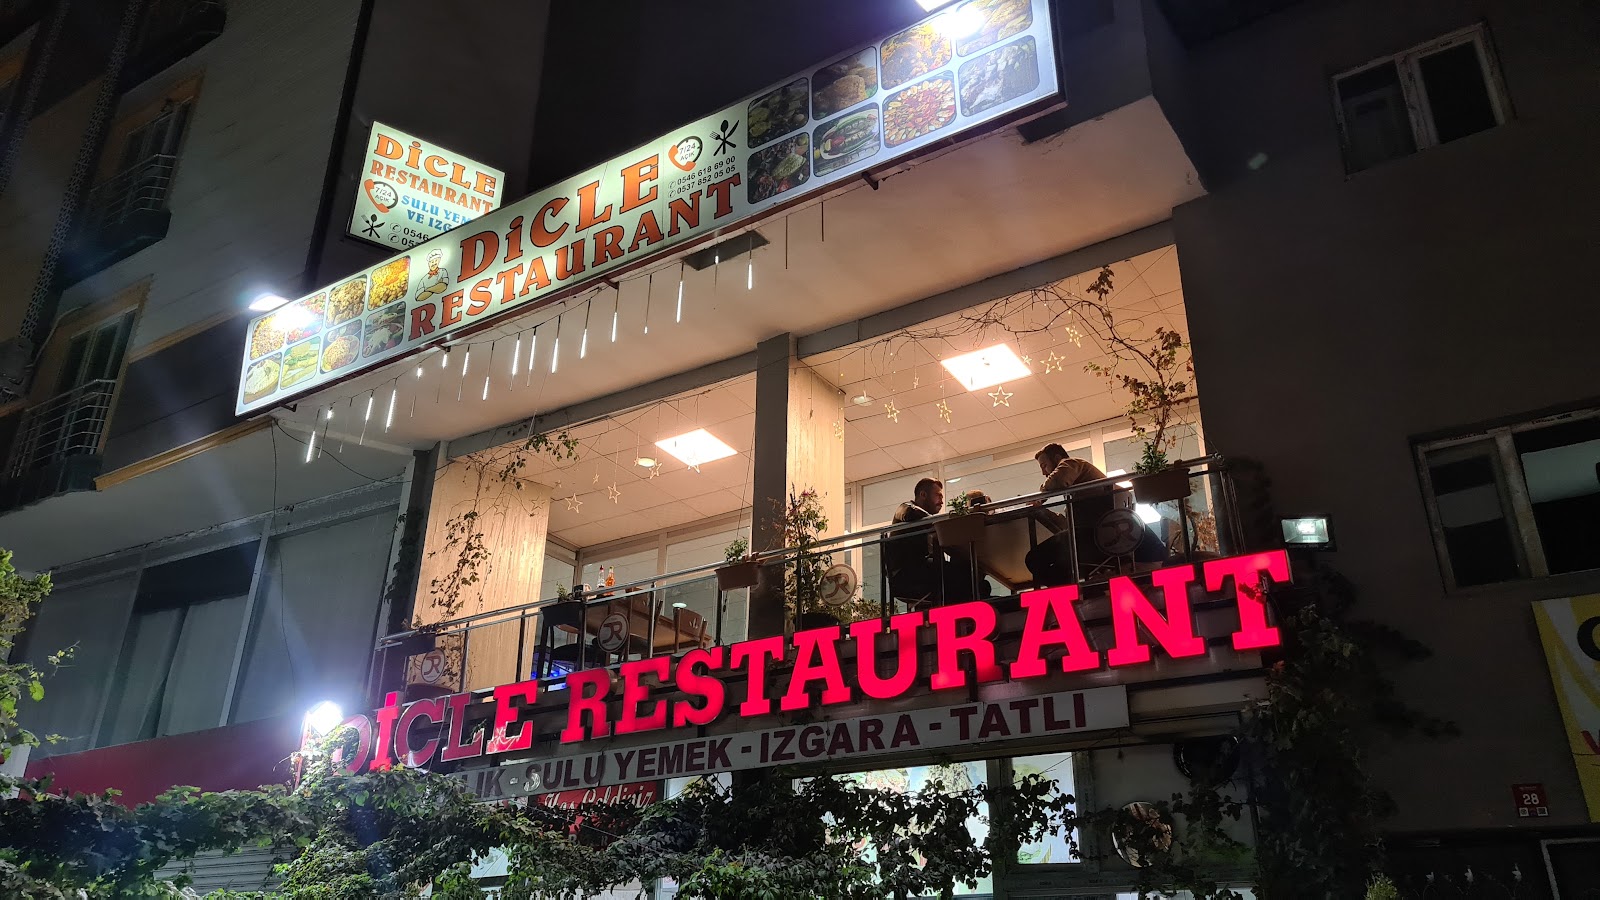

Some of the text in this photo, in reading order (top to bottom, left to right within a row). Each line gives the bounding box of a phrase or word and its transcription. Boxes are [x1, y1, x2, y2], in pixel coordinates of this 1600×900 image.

[679, 143, 696, 155] 7/24
[680, 150, 695, 161] AÇIK
[677, 155, 736, 186] 0546 618 69 00
[677, 164, 736, 195] 0537 852 05 05
[370, 159, 494, 215] RESTAURANT
[375, 187, 392, 198] 7/24
[401, 195, 439, 216] SULU
[407, 209, 425, 225] VE
[403, 227, 429, 241] 0546
[408, 173, 741, 341] RESTAURANT
[560, 549, 1292, 745] RESTAURANT
[523, 753, 607, 792] SULU
[614, 737, 733, 781] YEMEK
[760, 713, 921, 764] IZGARA
[950, 693, 1087, 741] TATLI
[1522, 793, 1539, 805] 28
